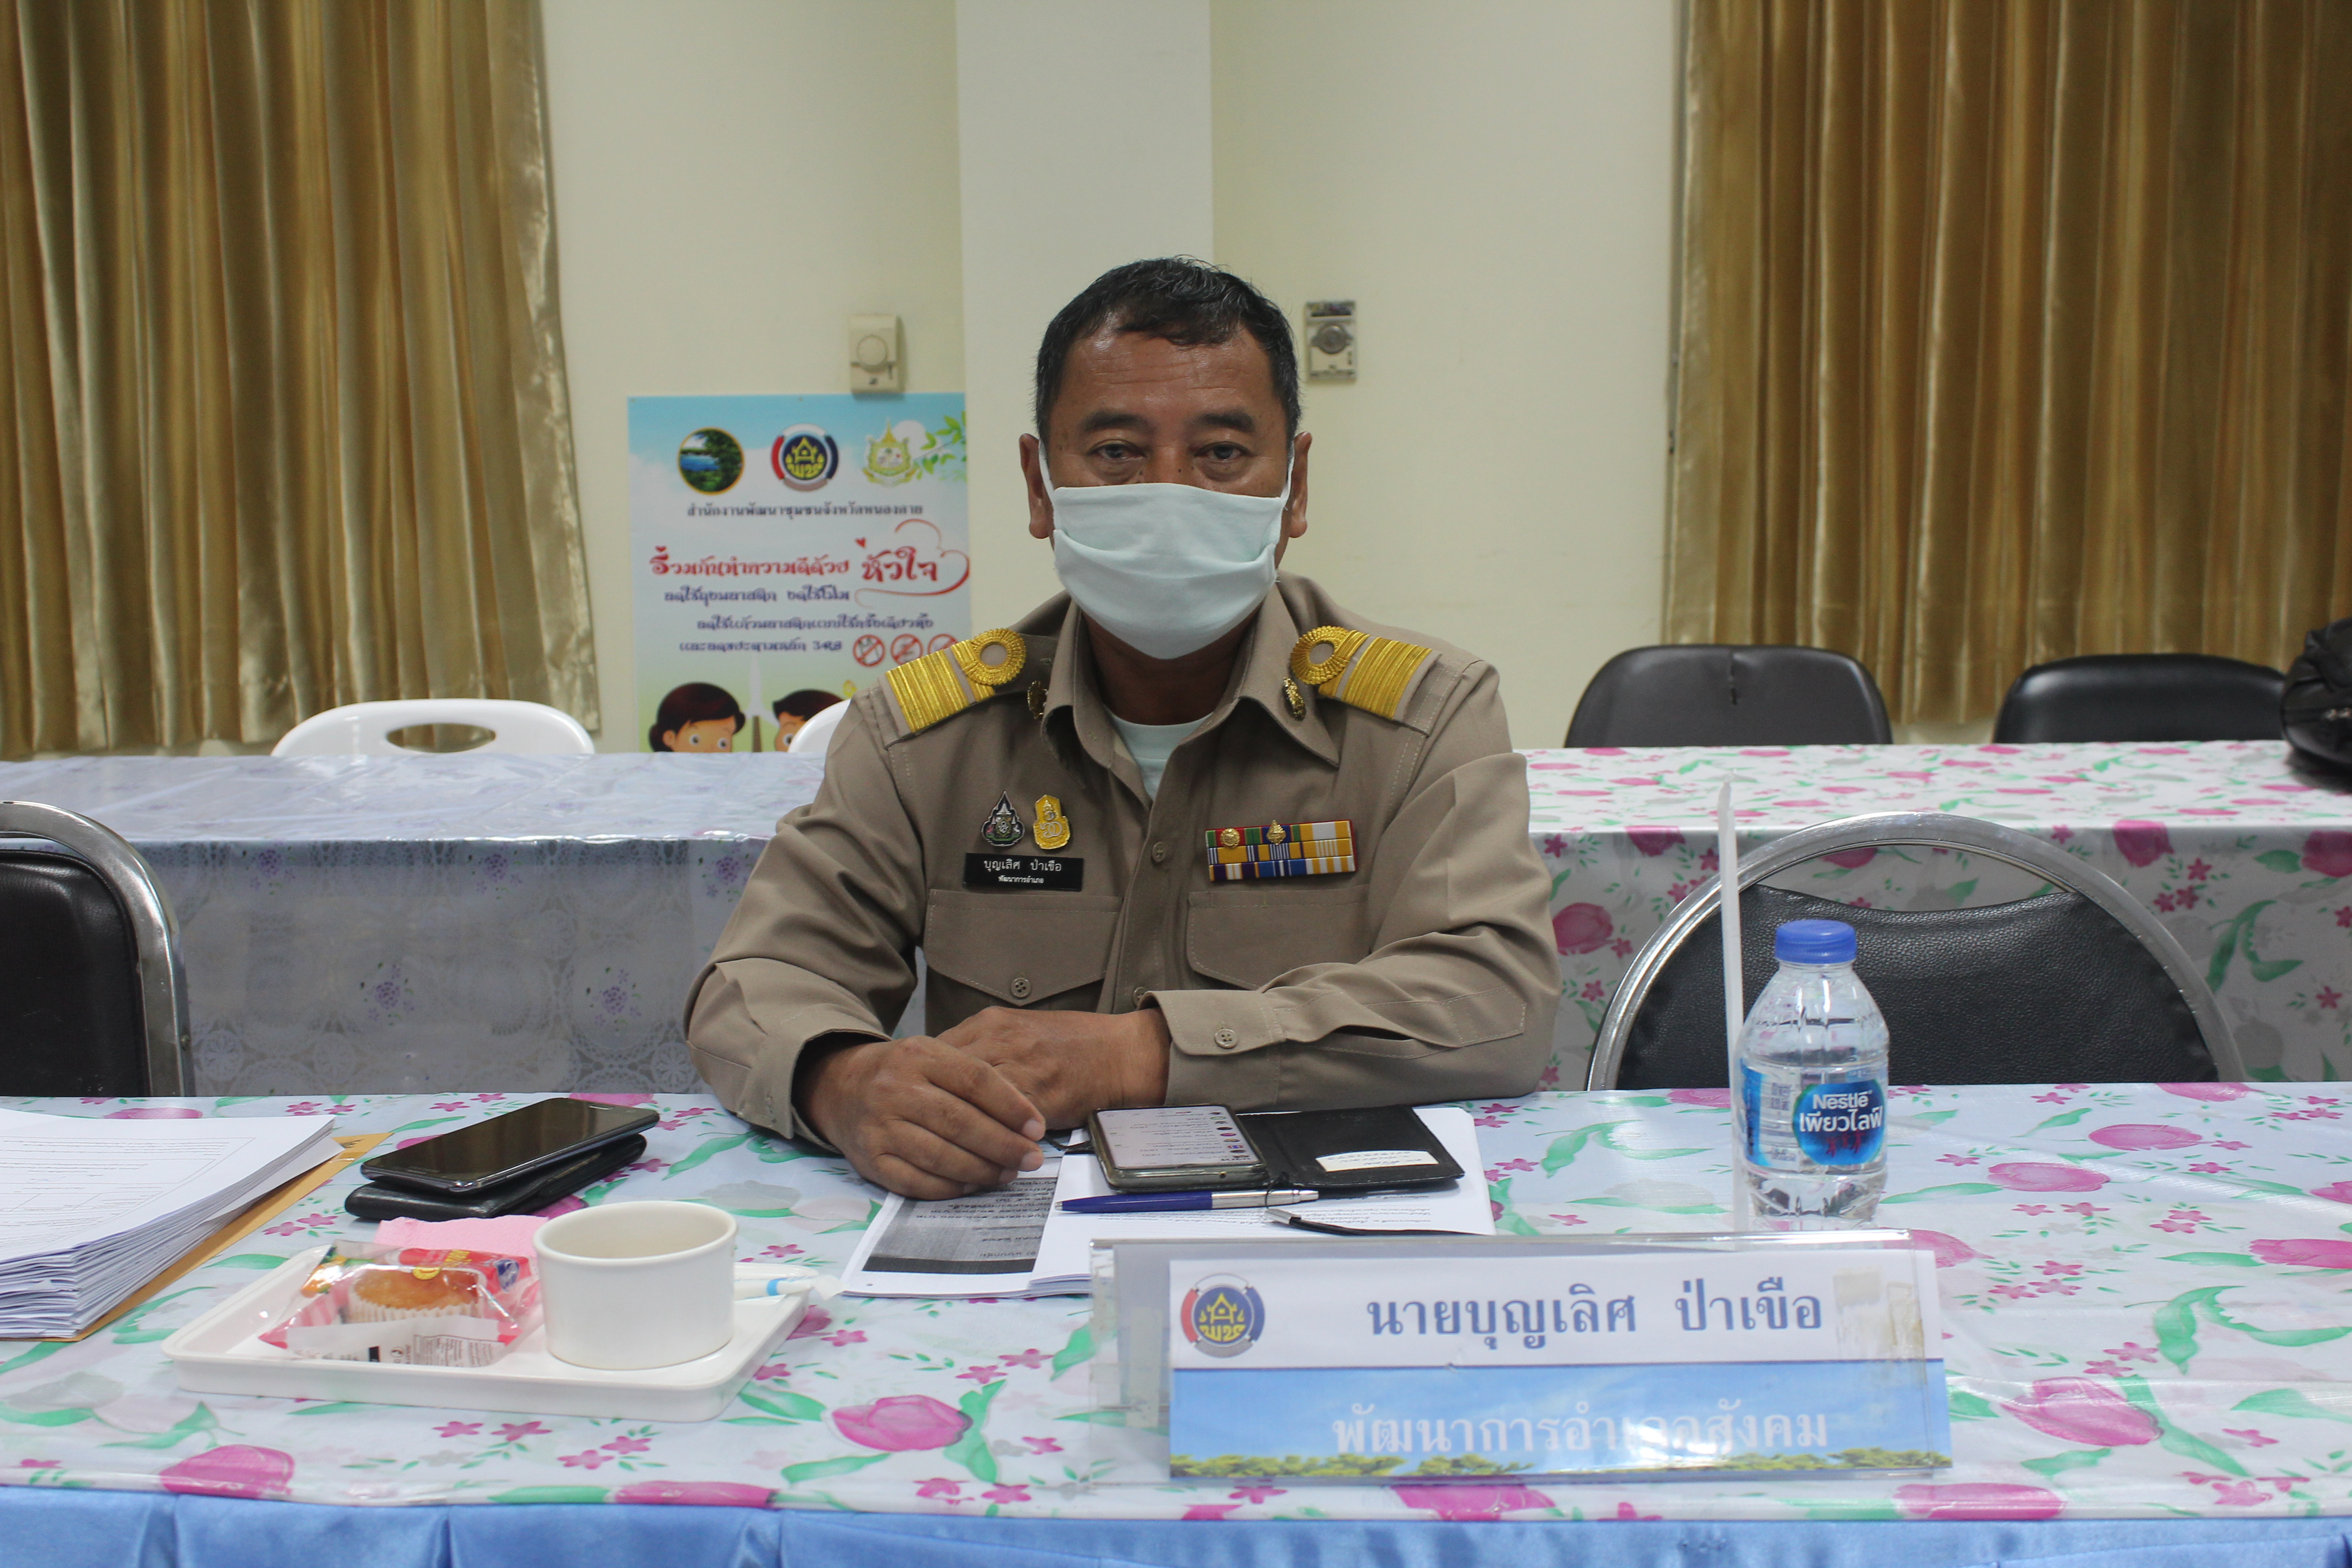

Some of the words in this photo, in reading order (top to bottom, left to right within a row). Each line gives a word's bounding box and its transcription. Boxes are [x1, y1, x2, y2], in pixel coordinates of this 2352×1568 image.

[984, 859, 1020, 872] บุญเลิศ
[1030, 859, 1062, 872] ป่าเขือ
[998, 875, 1044, 884] พัฒนาการอำเภอ
[1813, 1091, 1869, 1110] Nestlé
[1366, 1282, 1637, 1350] นายบุญเลิศ
[1676, 1275, 1822, 1333] ป่าเขือ
